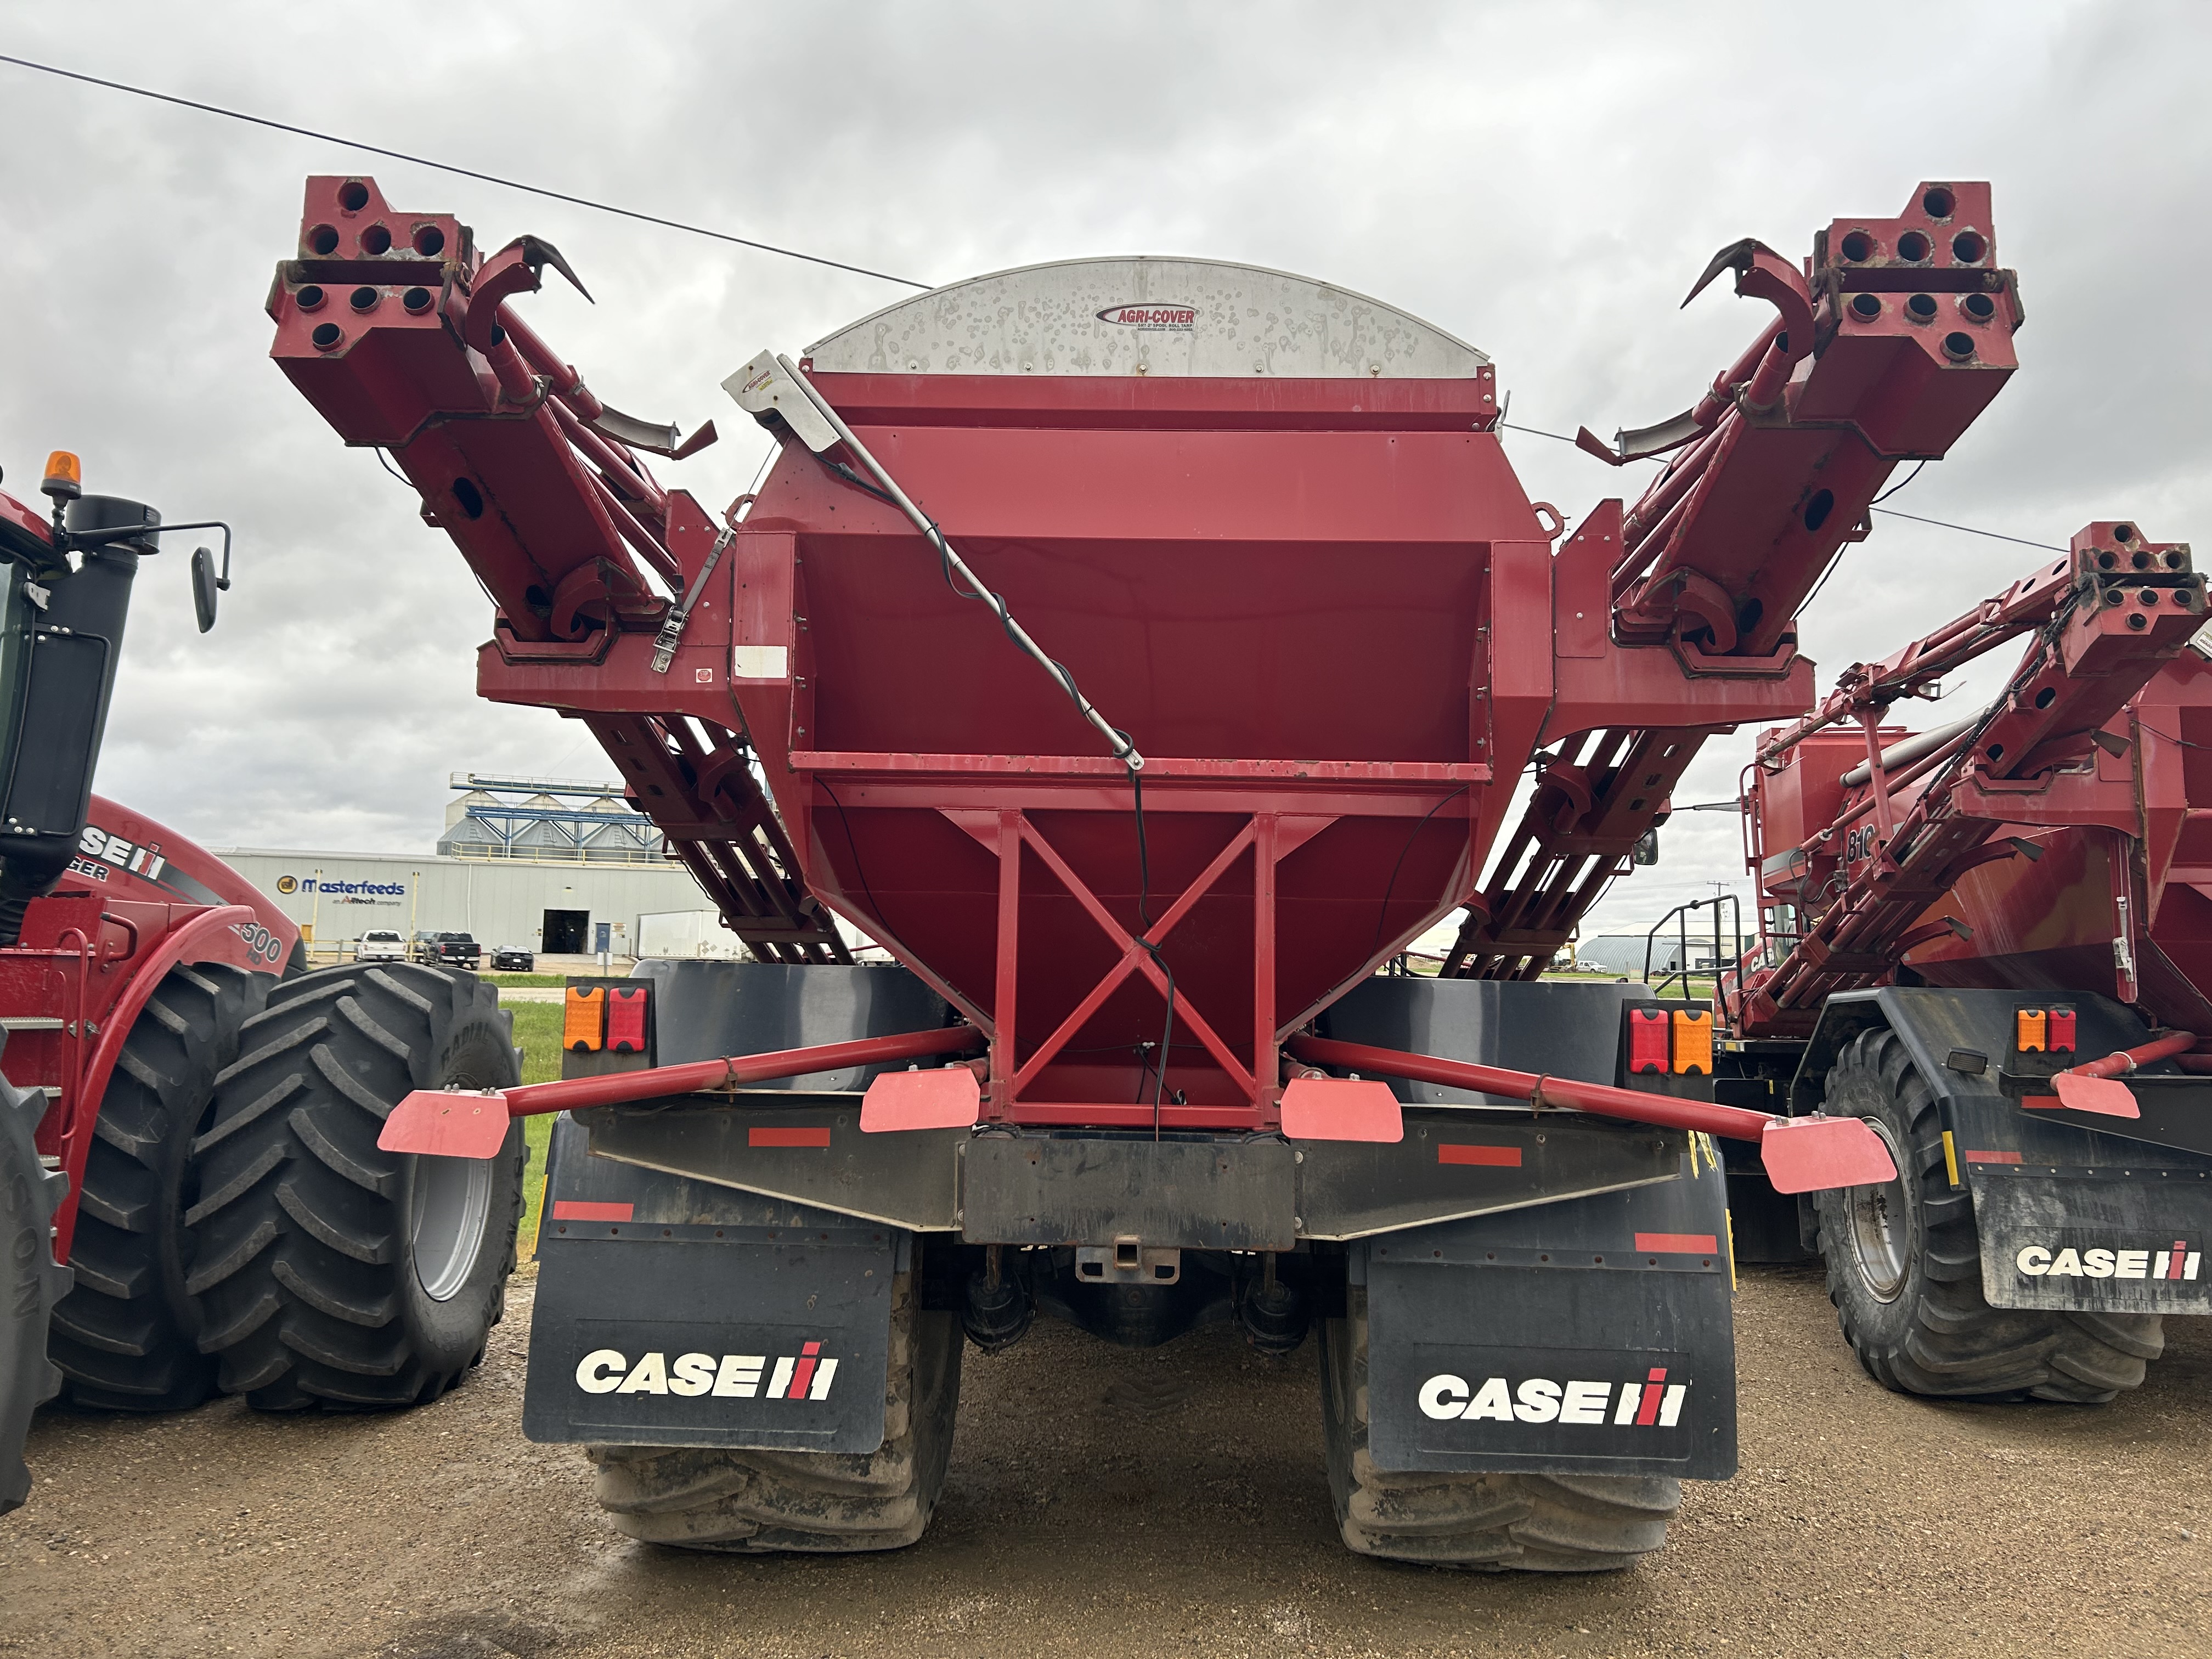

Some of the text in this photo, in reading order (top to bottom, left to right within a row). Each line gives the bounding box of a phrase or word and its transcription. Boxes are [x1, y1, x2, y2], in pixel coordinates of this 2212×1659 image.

[1118, 309, 1194, 324] AGRI-COVER
[748, 370, 771, 390] AGRI-COVER
[79, 826, 133, 866] SE
[241, 921, 282, 963] 500
[246, 949, 262, 965] HD
[2017, 1245, 2149, 1279] CASE
[575, 1349, 766, 1398] CASE
[1418, 1374, 1612, 1424] CASE
